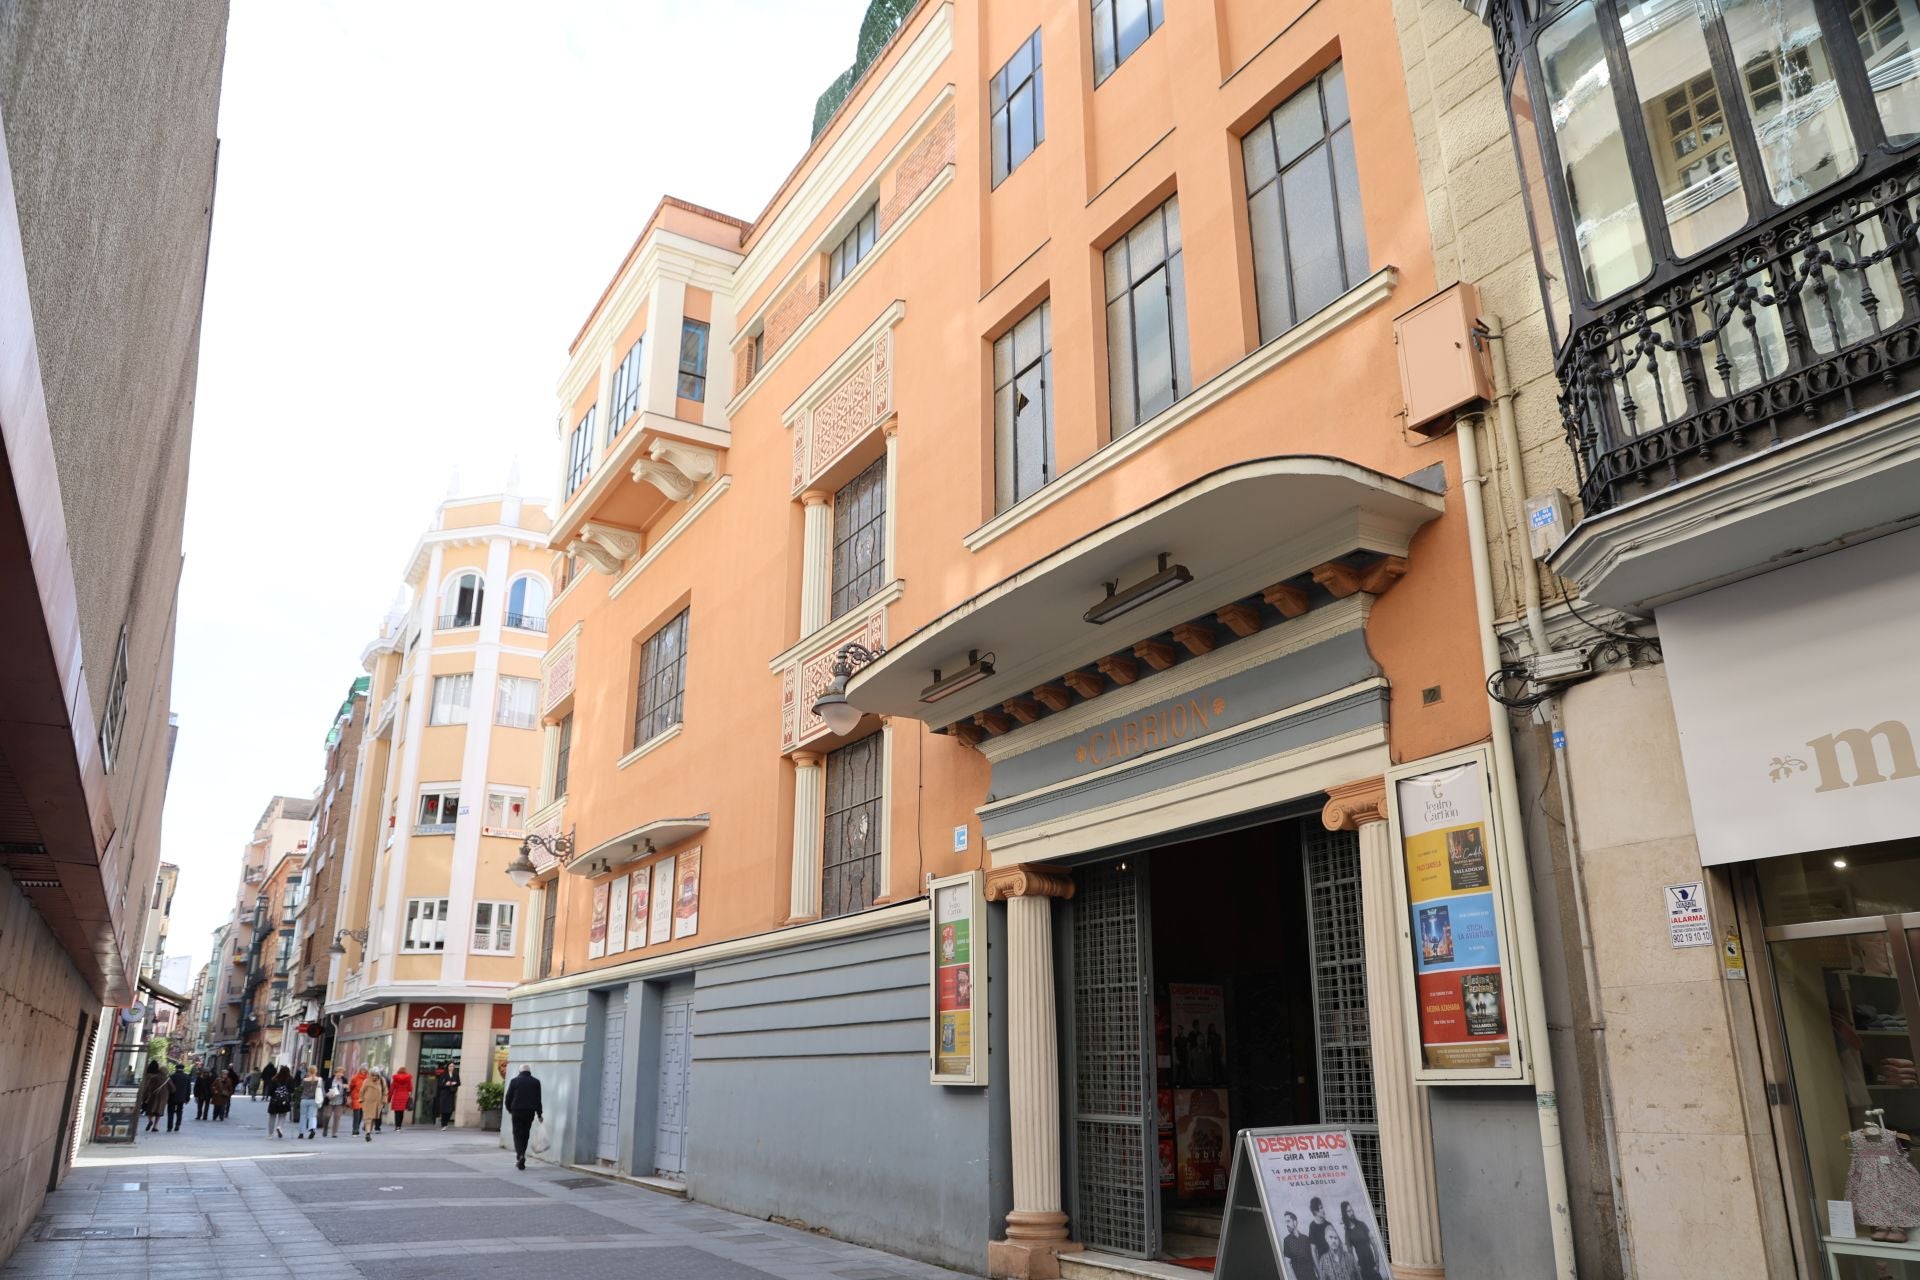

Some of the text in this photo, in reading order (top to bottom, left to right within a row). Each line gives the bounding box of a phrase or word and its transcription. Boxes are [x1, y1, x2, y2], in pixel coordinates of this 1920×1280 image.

[1089, 694, 1210, 766] CARRION
[1673, 934, 1684, 943] 902
[1685, 933, 1693, 941] 19
[1694, 931, 1702, 941] 10
[412, 1015, 457, 1028] arenal
[1257, 1134, 1347, 1153] DESPISTAOS
[1283, 1153, 1305, 1161] GIRA
[1284, 1166, 1316, 1174] MARZO
[1289, 1179, 1336, 1187] VALLADOLID
